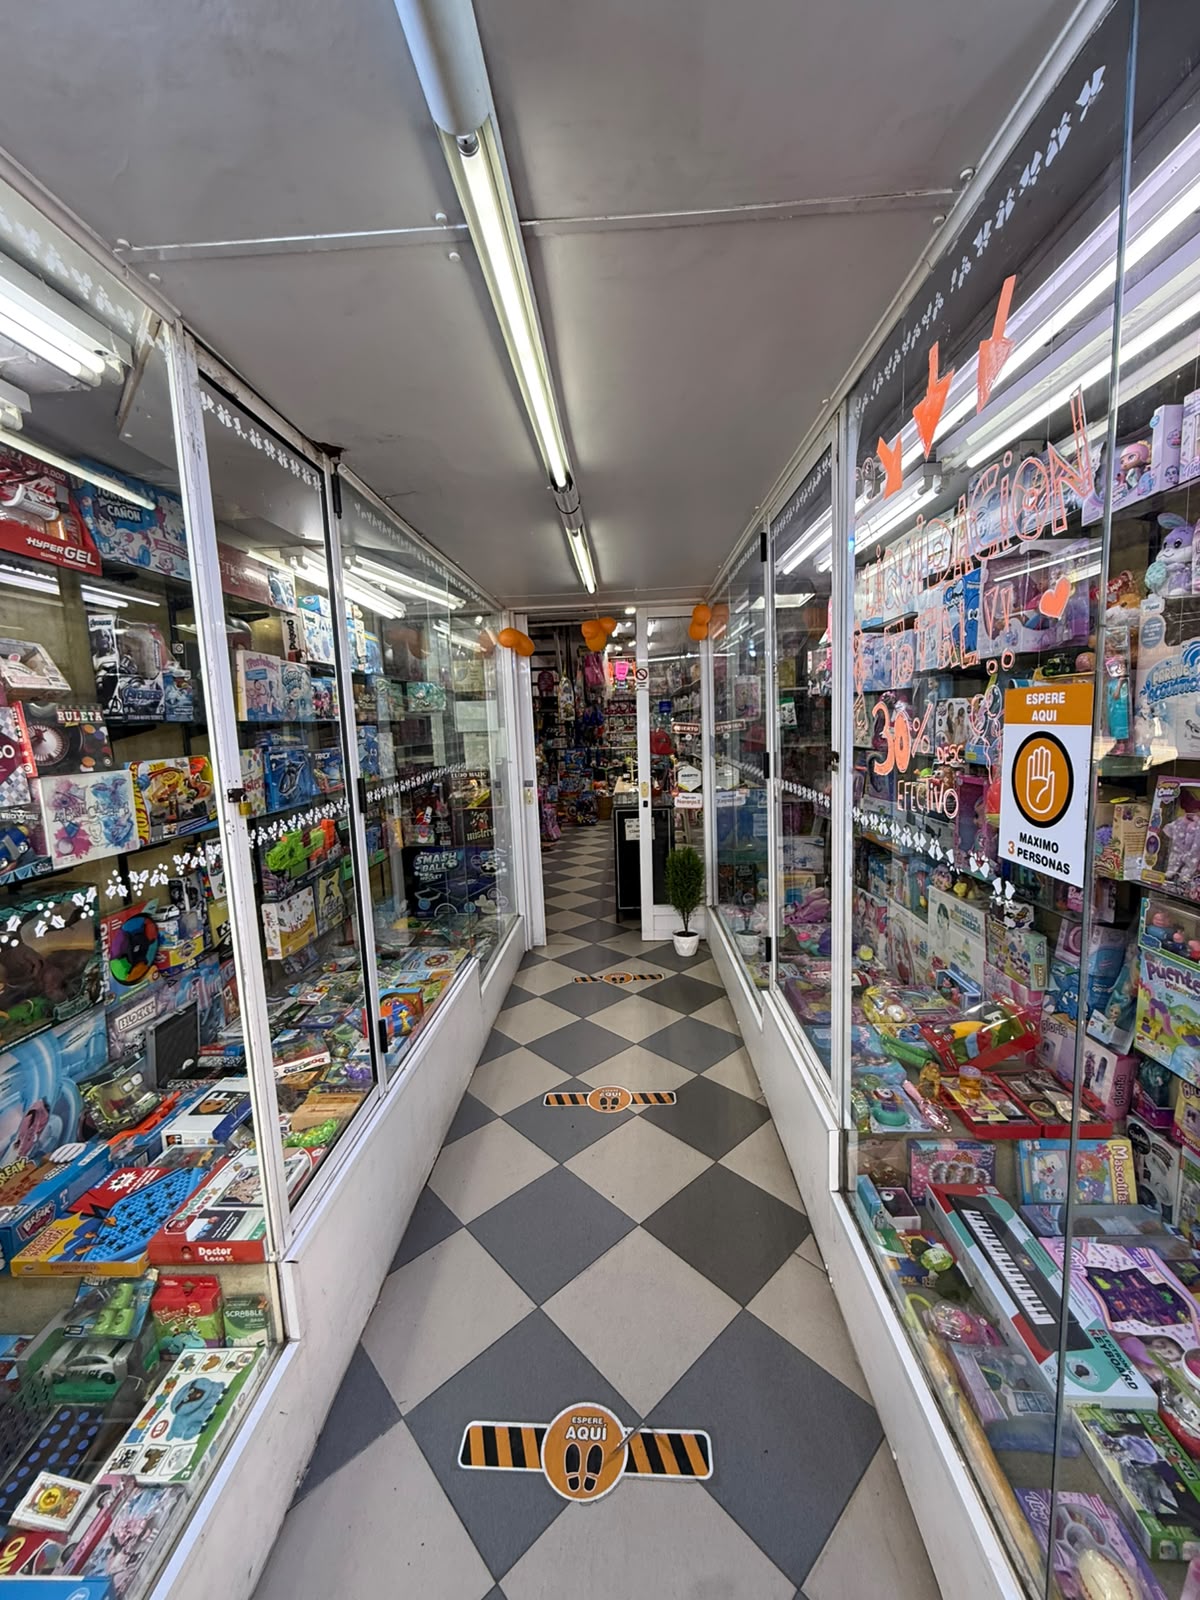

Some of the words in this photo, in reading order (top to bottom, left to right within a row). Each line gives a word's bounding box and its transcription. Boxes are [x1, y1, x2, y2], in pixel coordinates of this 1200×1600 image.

[107, 504, 141, 521] CAÑON
[1026, 692, 1066, 705] ESPERE
[56, 711, 103, 721] RULETA
[1031, 710, 1057, 722] AQUI
[872, 701, 933, 776] 30%
[1019, 832, 1059, 854] MAXIMO
[415, 851, 457, 865] SMASH
[1007, 841, 1015, 854] 3
[1017, 848, 1070, 875] PERSONAS
[422, 863, 447, 871] BALL
[100, 923, 111, 992] DESAFIO
[198, 1247, 232, 1256] Doctor
[225, 1309, 263, 1318] SCRABBLE
[1088, 1329, 1139, 1390] KEYBOARD
[572, 1416, 603, 1424] ESPERE
